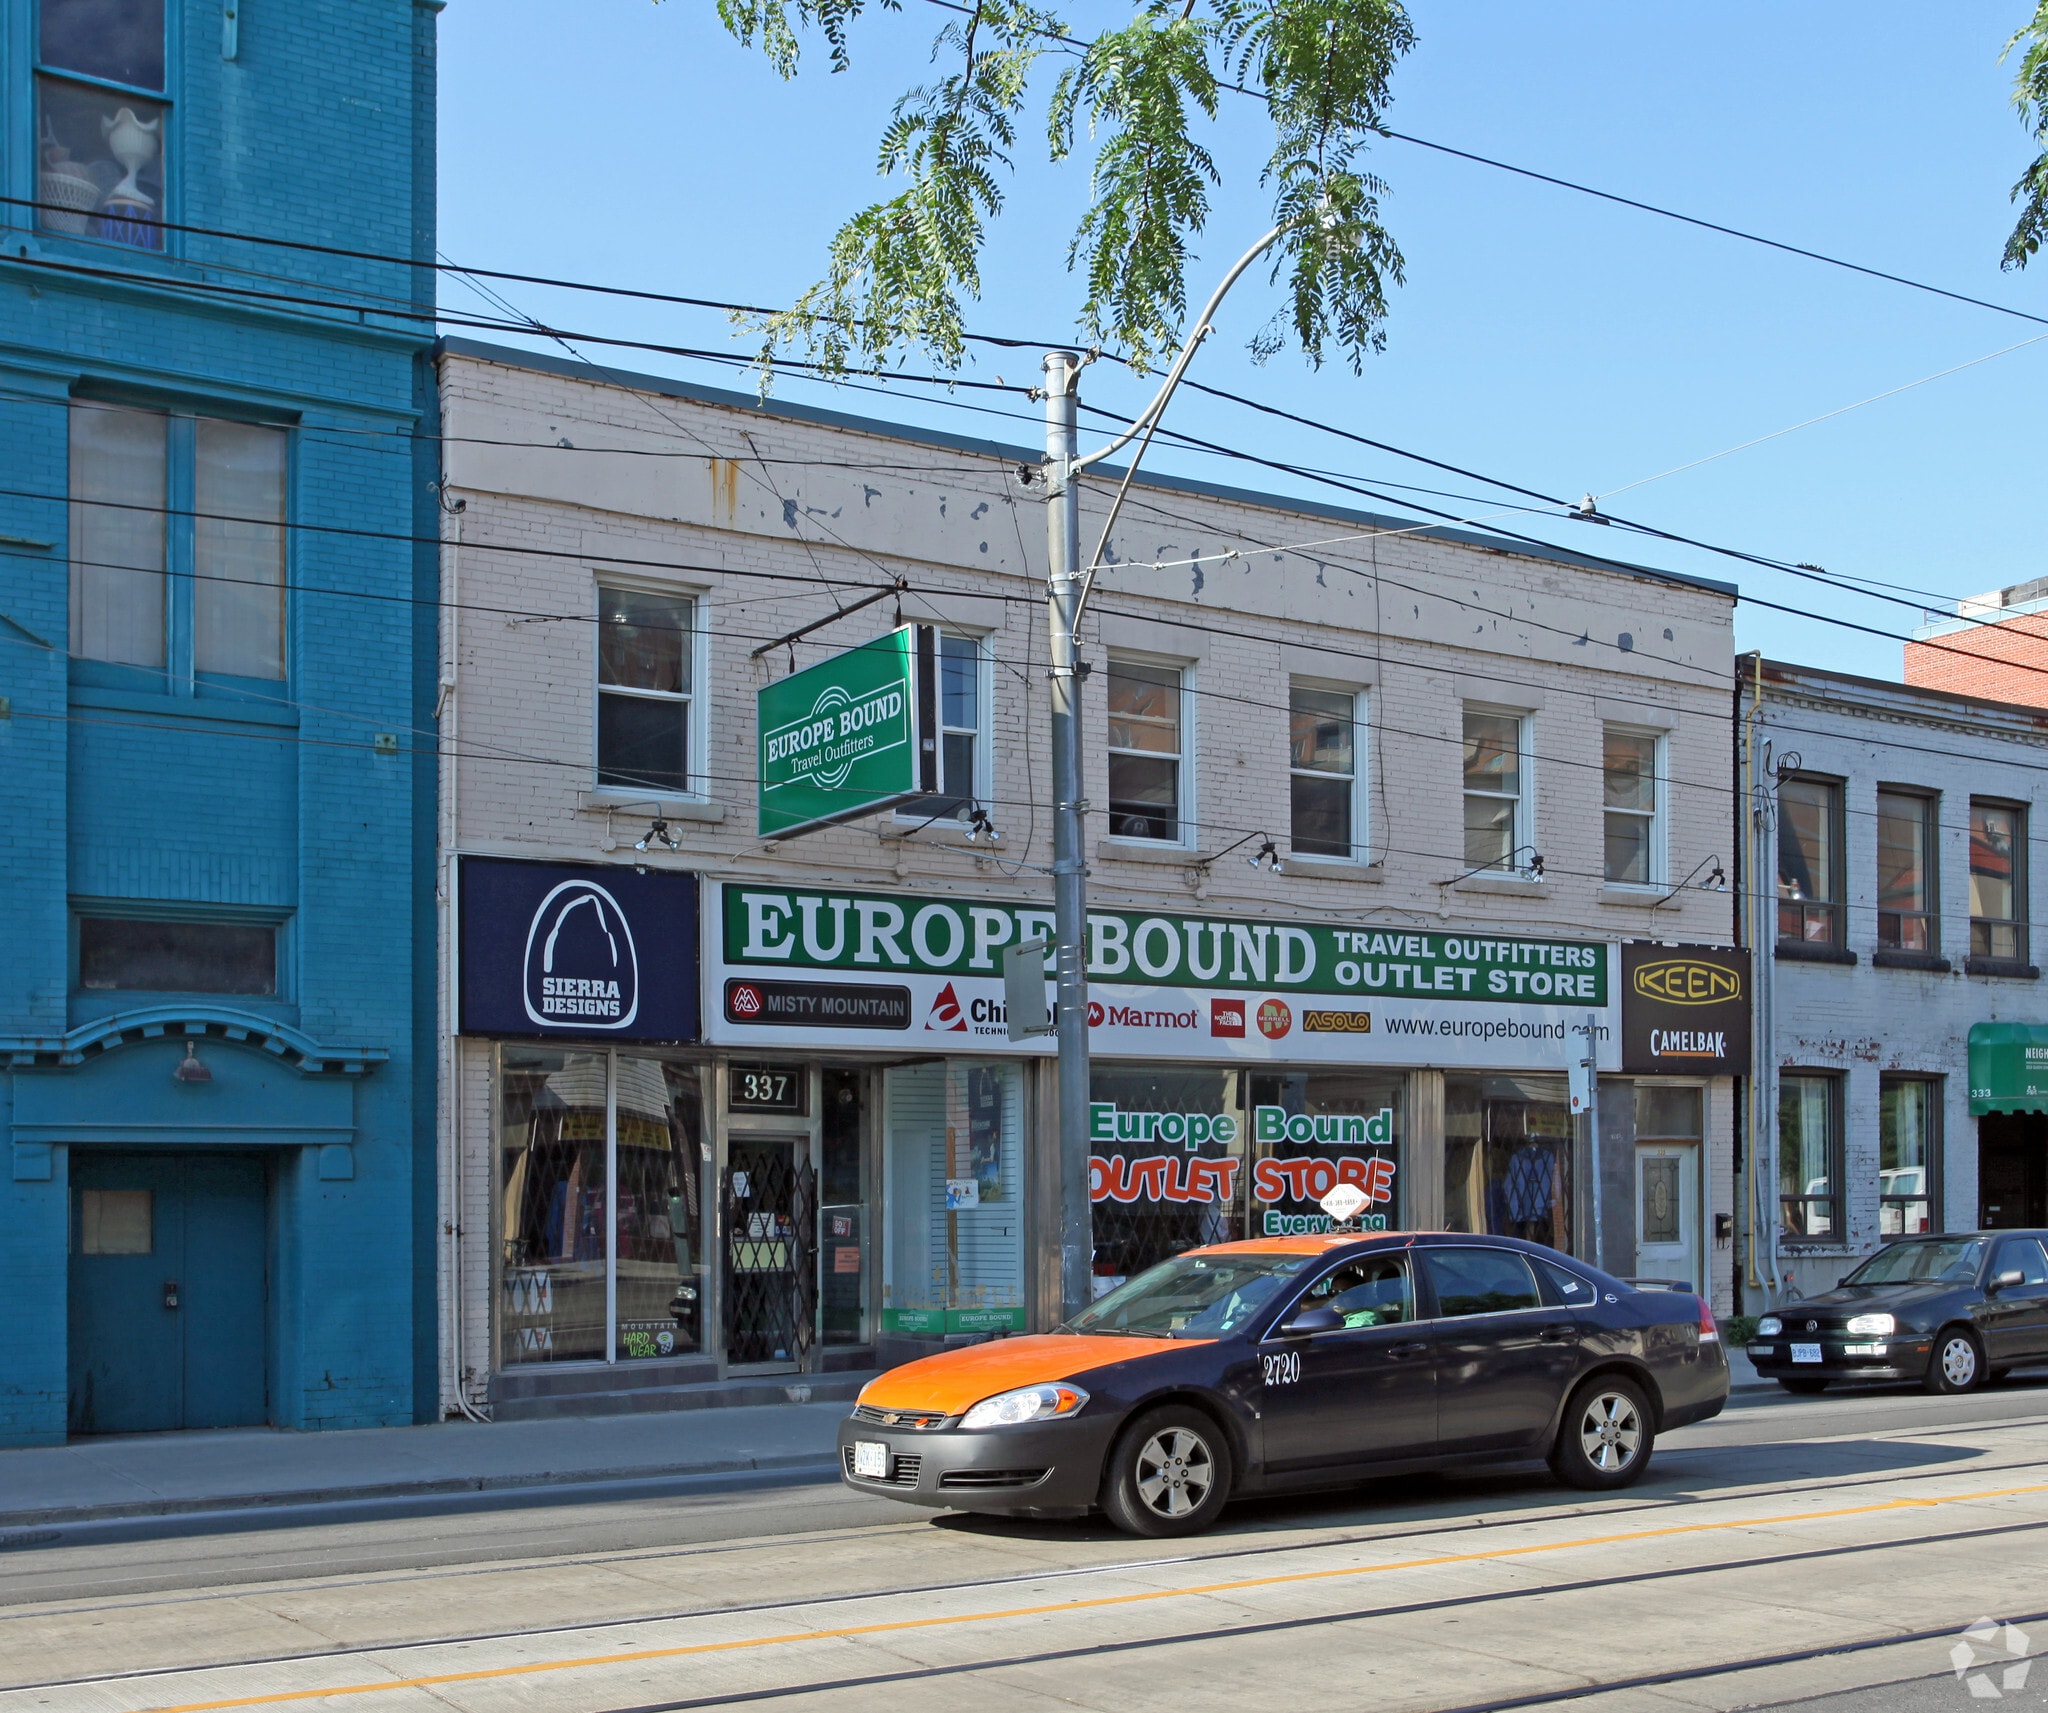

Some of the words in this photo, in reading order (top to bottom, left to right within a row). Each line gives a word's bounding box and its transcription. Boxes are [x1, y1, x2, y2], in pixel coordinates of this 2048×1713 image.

[768, 717, 834, 763] EUROPE
[840, 691, 902, 737] BOUND
[791, 750, 822, 774] Travel
[825, 734, 874, 762] Outfitters
[742, 893, 1057, 972] EUROPE
[1087, 914, 1317, 984] BOUND
[1333, 931, 1436, 958] TRAVEL
[1444, 938, 1596, 968] OUTFITTERS
[543, 977, 621, 998] SIERRA
[1335, 960, 1477, 992] OUTLET
[1487, 969, 1596, 998] STORE
[1640, 966, 1735, 998] KEEN
[543, 997, 621, 1016] DESIGNS
[768, 995, 817, 1013] MISTY
[822, 998, 905, 1016] MOUNTAIN
[1108, 1005, 1198, 1029] Marmot
[1304, 1011, 1370, 1033] ASOLO
[1385, 1018, 1609, 1042] www.europeboundm
[1650, 1028, 1726, 1058] CAMELBAK
[744, 1073, 788, 1101] 337
[1971, 1088, 1991, 1098] 333
[1090, 1101, 1238, 1151] Europe
[1255, 1105, 1392, 1144] Bound
[1090, 1155, 1239, 1202] OUTLET
[1254, 1156, 1395, 1202] STORE
[621, 1322, 678, 1330] MOUNTAIN
[961, 1314, 988, 1322] EUROPE
[623, 1332, 650, 1345] HARD
[629, 1344, 657, 1357] WEAR
[1263, 1351, 1301, 1386] 2720
